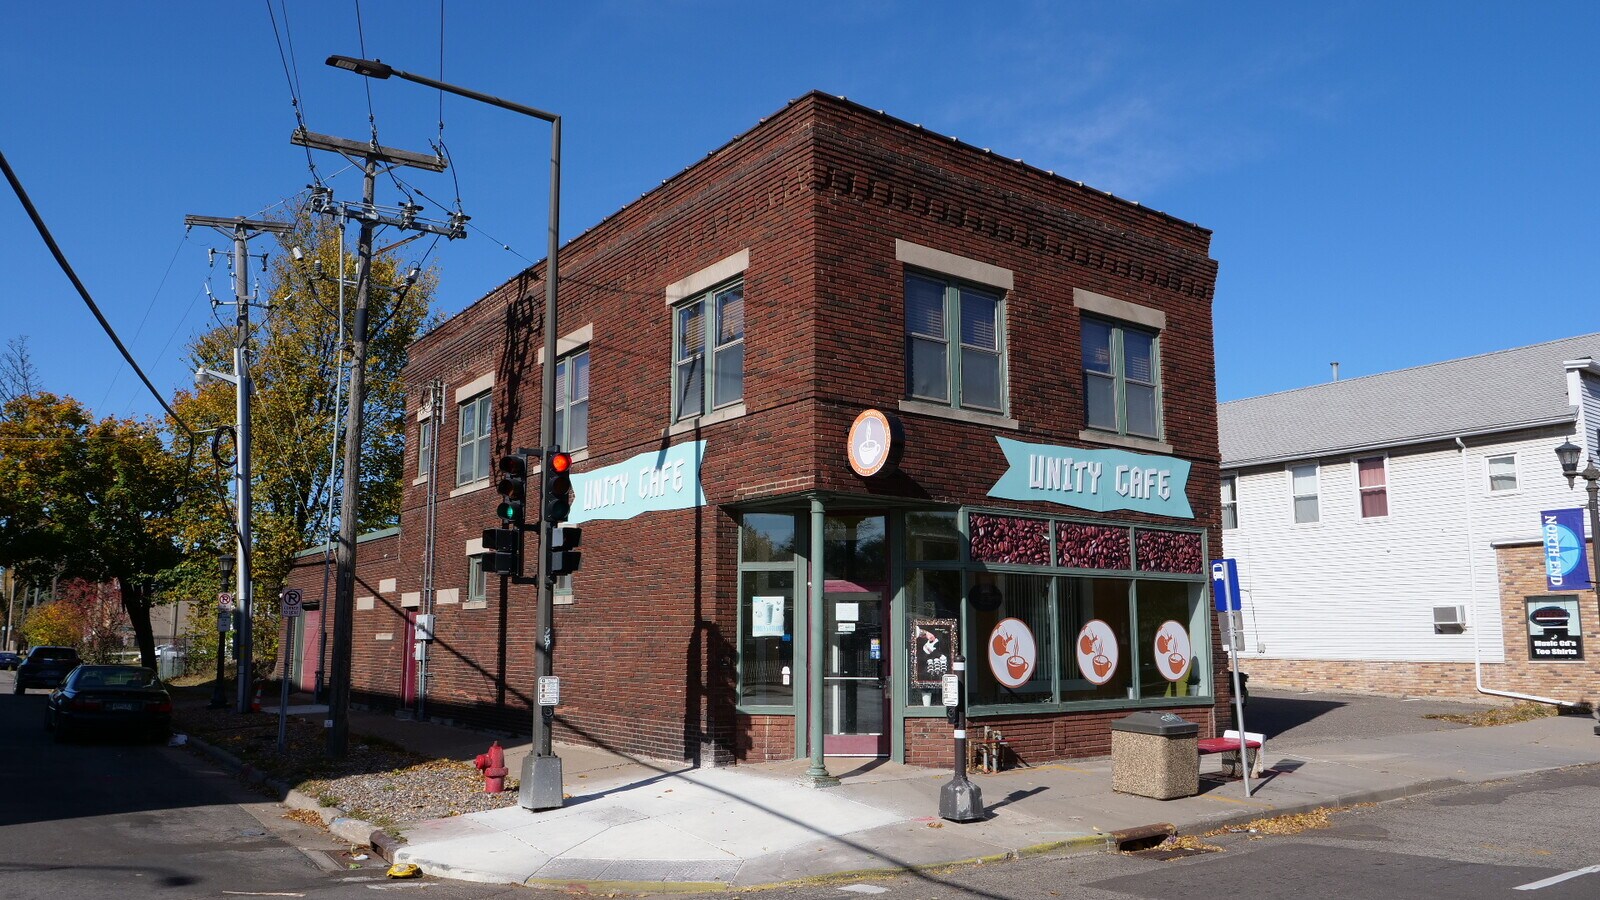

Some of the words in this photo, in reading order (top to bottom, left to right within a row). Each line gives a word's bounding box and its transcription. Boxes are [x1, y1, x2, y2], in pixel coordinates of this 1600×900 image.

[584, 471, 629, 511] UNITY
[639, 458, 686, 499] CAFE
[1029, 454, 1102, 494] UNITY
[1115, 464, 1171, 501] CAFE
[1545, 515, 1561, 557] NORTH
[1550, 562, 1563, 586] END
